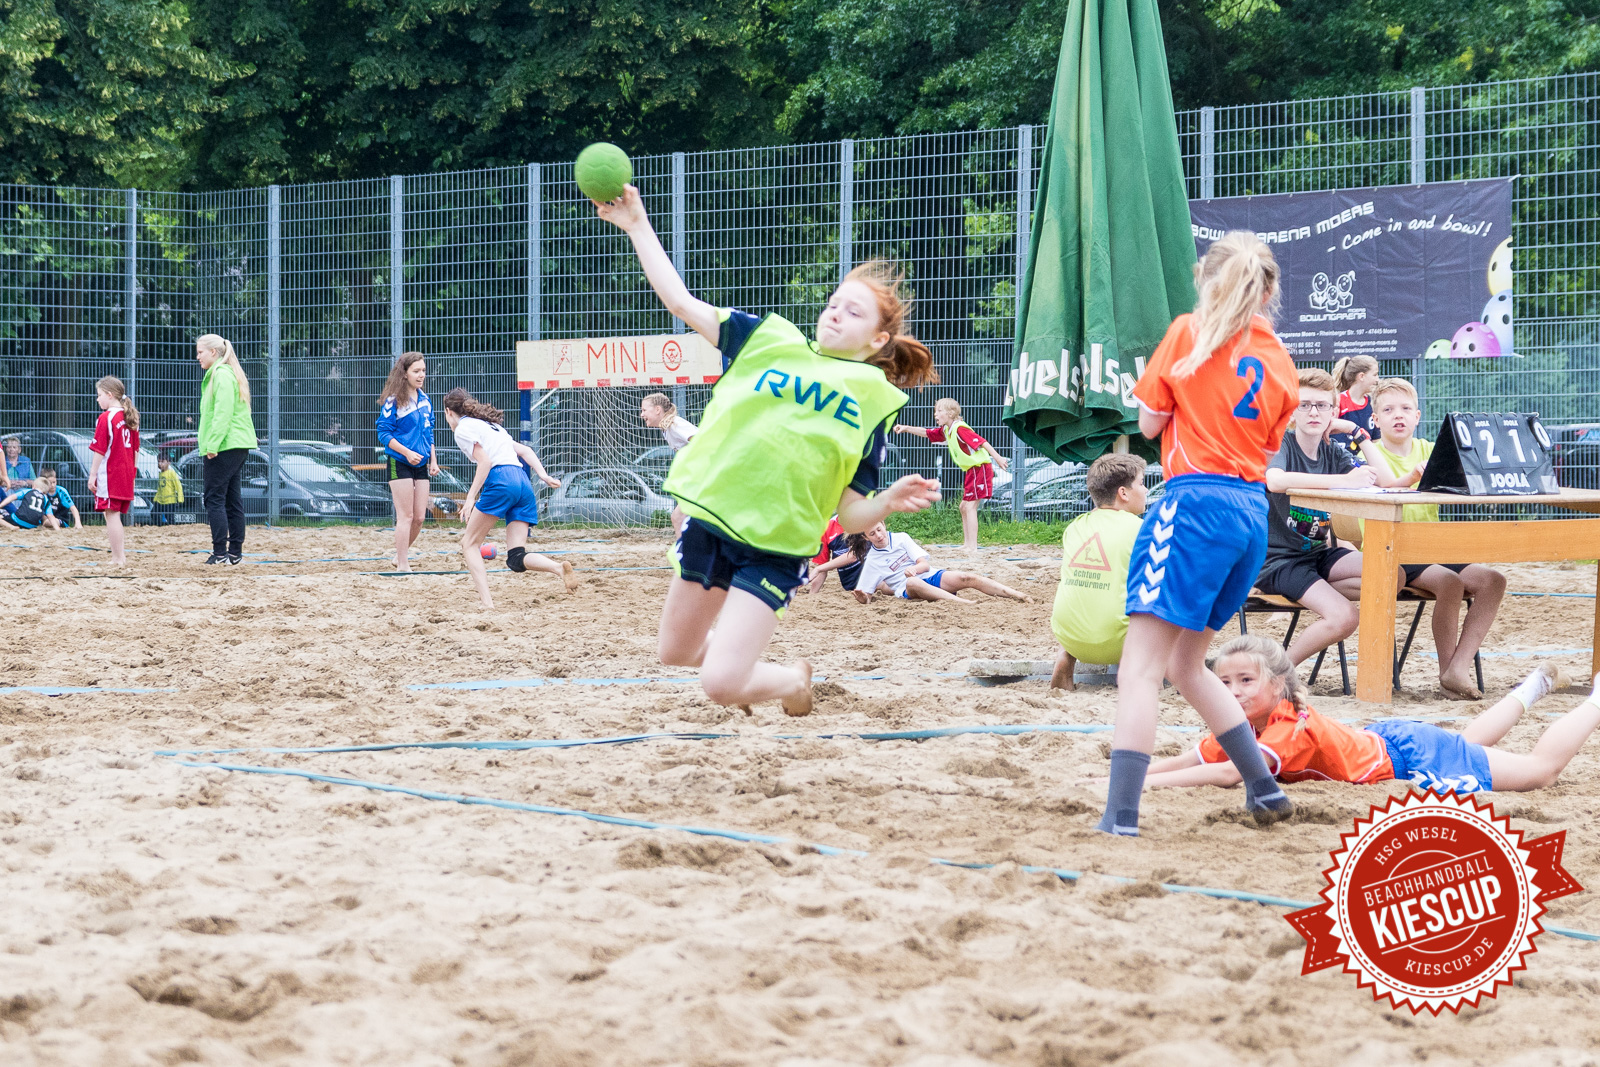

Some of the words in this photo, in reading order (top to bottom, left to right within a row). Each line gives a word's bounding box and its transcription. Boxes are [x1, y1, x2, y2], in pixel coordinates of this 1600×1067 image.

[1316, 201, 1374, 234] MOERS
[1342, 226, 1382, 250] Come
[1388, 217, 1402, 232] in
[1408, 214, 1436, 230] and
[1441, 213, 1492, 237] bowl!
[1299, 312, 1367, 322] BOWLINGARENA
[587, 341, 646, 374] MINI
[754, 368, 860, 430] RWE
[1232, 355, 1265, 421] 2
[121, 428, 132, 448] 12
[1456, 420, 1472, 447] 0
[1479, 424, 1501, 463] 2
[1508, 424, 1526, 462] 1
[1533, 421, 1551, 448] 0
[1490, 472, 1530, 488] JOOLA
[29, 495, 43, 512] 11
